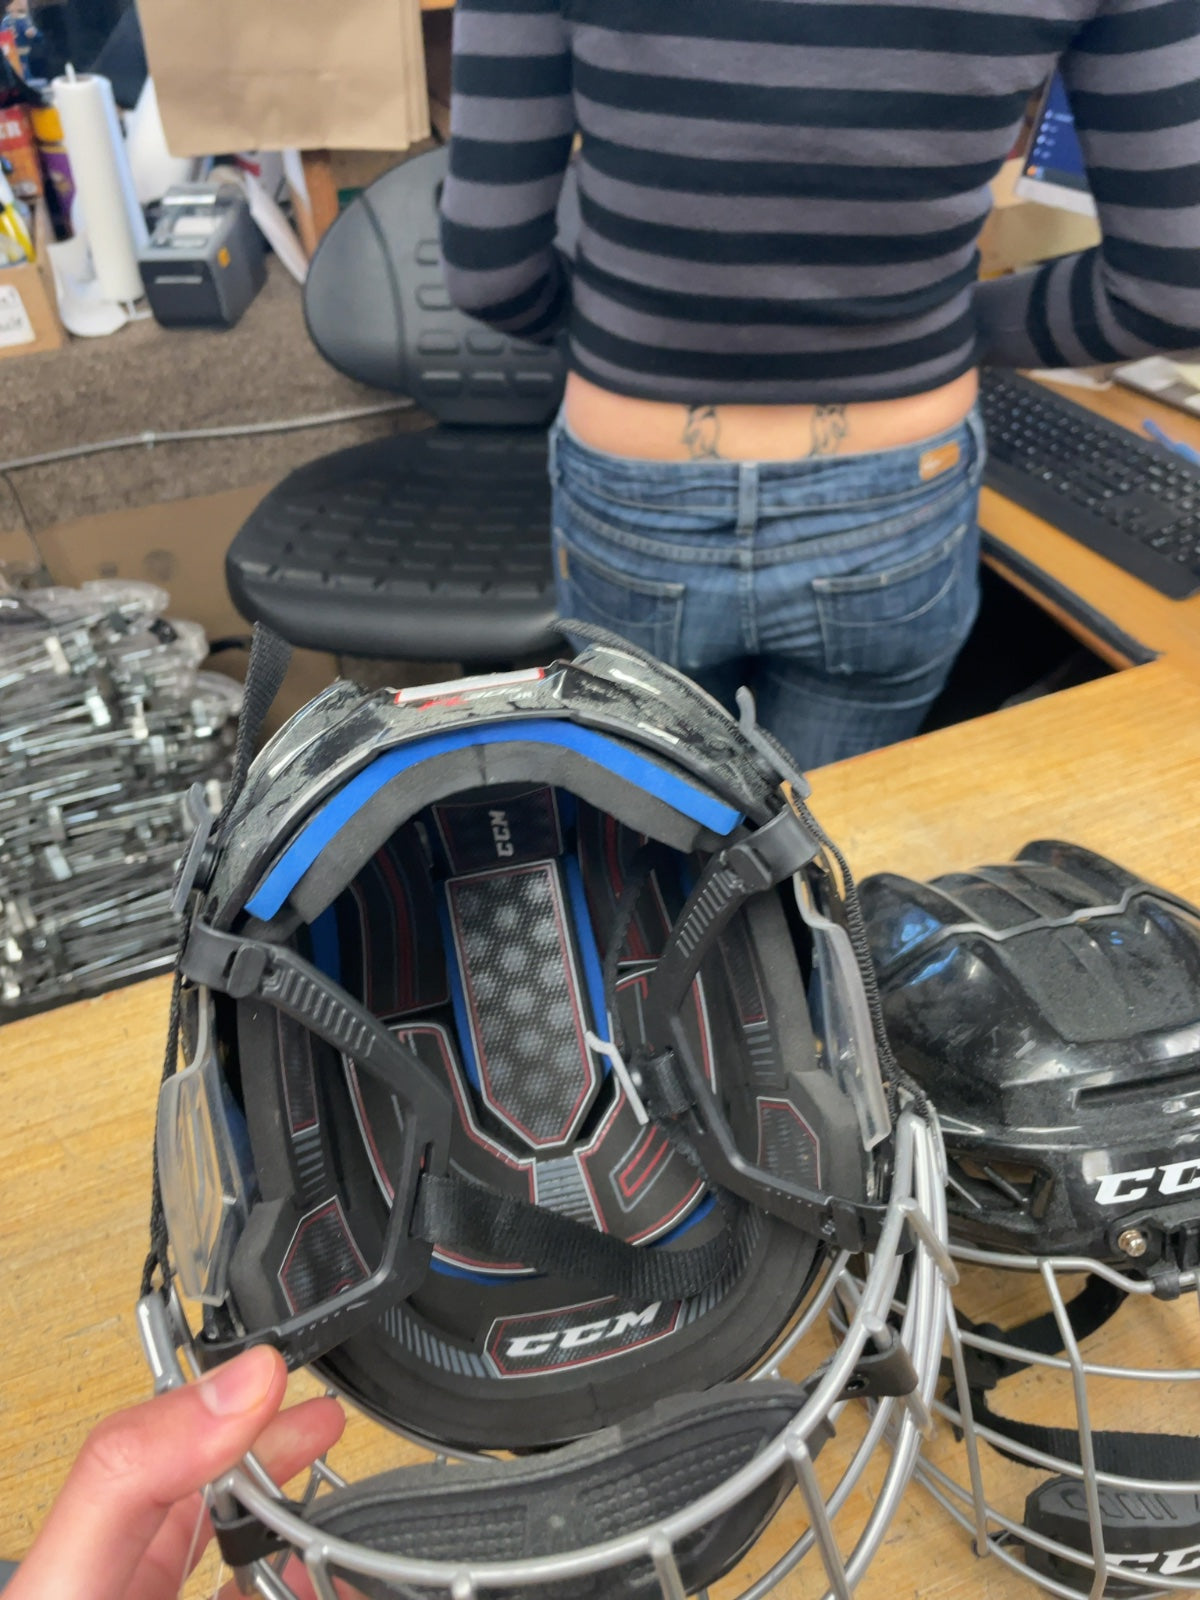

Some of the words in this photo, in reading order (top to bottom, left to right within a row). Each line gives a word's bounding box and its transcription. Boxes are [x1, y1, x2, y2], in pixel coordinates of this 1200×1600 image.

[488, 810, 514, 857] CCM
[1095, 1158, 1200, 1205] CC
[505, 1301, 662, 1357] CCM
